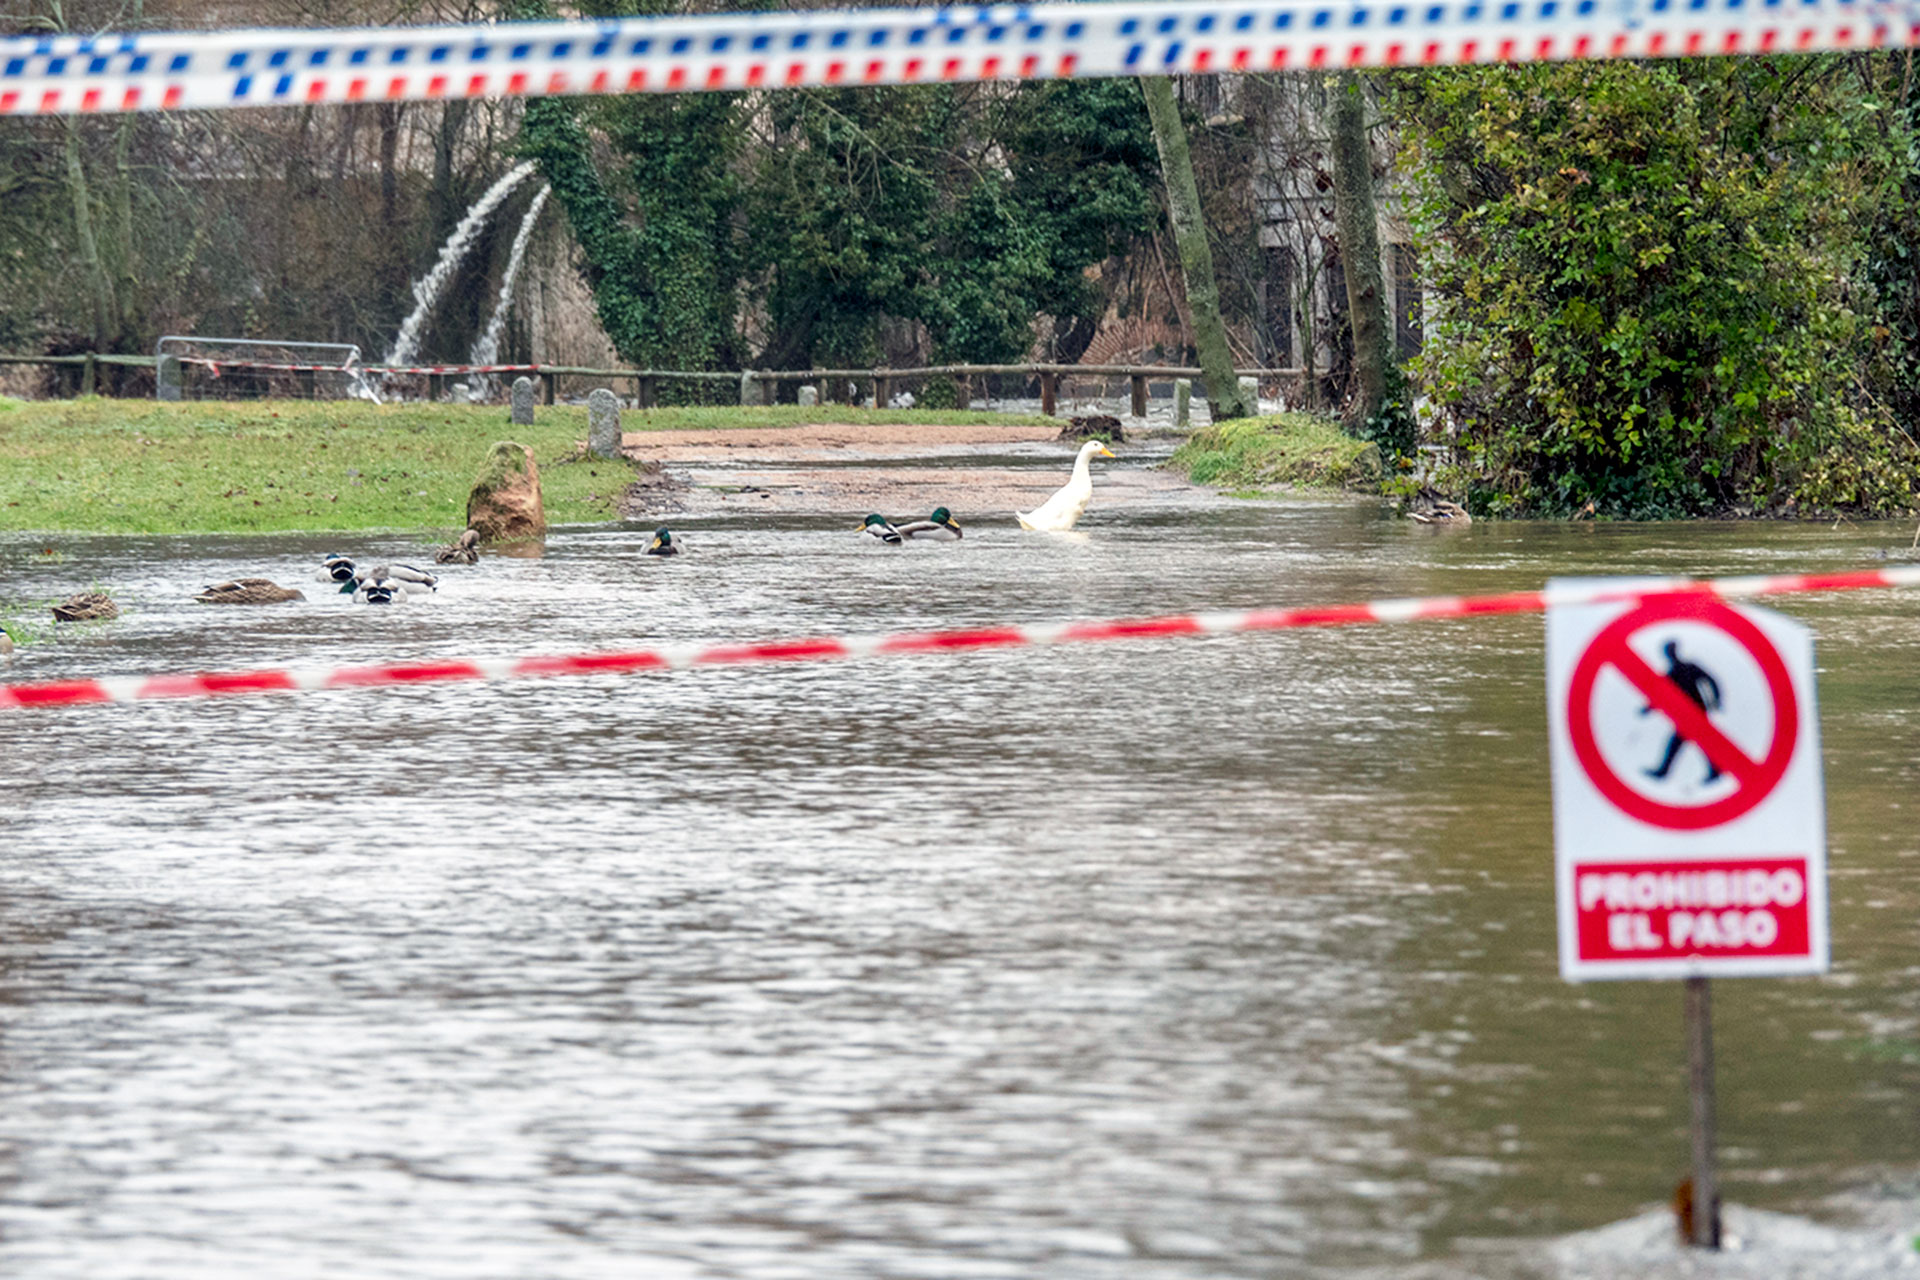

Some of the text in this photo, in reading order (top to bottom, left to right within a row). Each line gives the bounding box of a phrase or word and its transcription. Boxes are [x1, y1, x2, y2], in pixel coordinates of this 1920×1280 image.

[1580, 868, 1803, 911] PROHIBIDO
[1608, 910, 1777, 950] EL PASO
